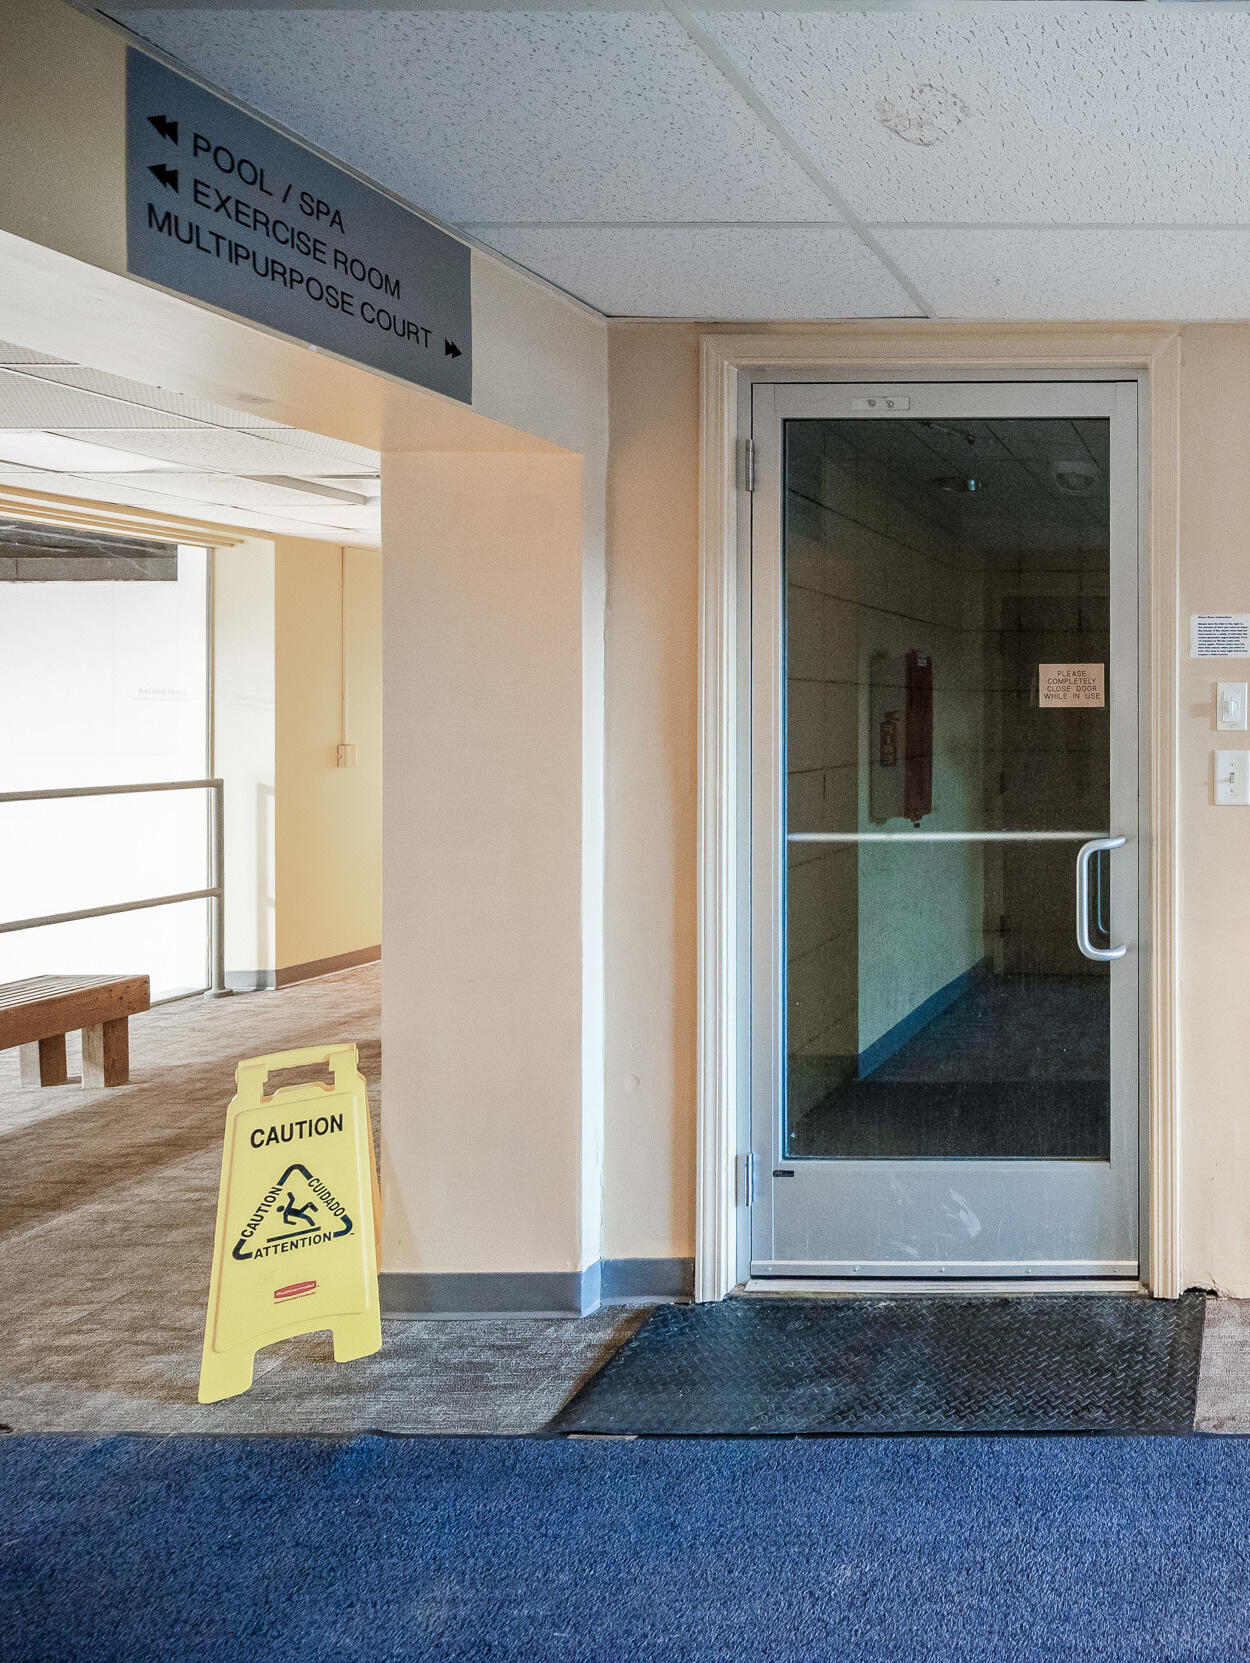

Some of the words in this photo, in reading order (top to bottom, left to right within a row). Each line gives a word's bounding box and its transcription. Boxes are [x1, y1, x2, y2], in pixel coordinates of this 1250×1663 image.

[192, 132, 273, 196] POOL
[299, 190, 346, 234] SPA
[193, 178, 328, 265] EXERCISE
[333, 247, 401, 300] ROOM
[146, 202, 355, 316] MULTIPURPOSE
[360, 300, 432, 348] COURT
[1047, 677, 1096, 685] COMPLETELY
[250, 1113, 343, 1149] CAUTION
[241, 1186, 283, 1238] CAUTION
[307, 1177, 346, 1217] CUIDADO
[253, 1231, 332, 1260] ATTENTION
